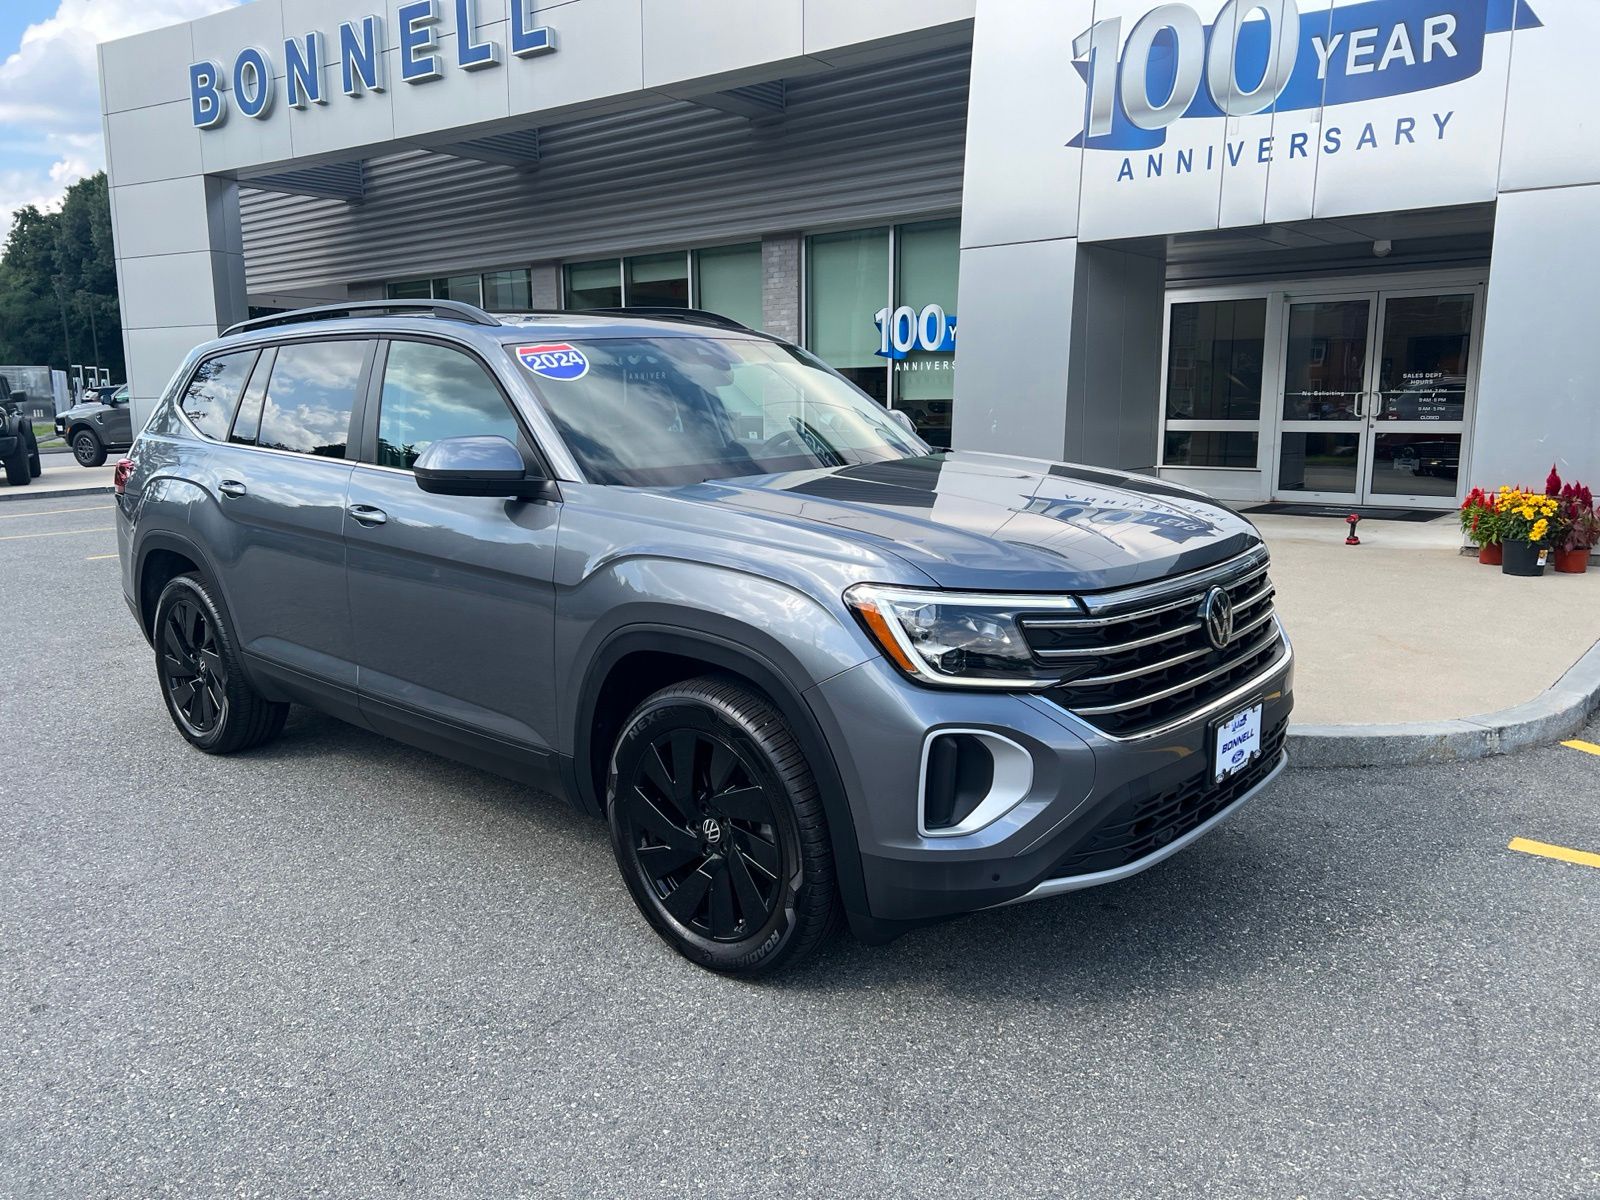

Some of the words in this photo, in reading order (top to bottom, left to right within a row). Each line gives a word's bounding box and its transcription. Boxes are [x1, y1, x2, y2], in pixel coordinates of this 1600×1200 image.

[189, 0, 557, 131] BONNELL
[1072, 0, 1299, 137] 100
[1311, 13, 1458, 81] YEAR
[1115, 110, 1456, 183] ANNIVERSARY
[875, 303, 946, 353] 100
[526, 351, 584, 371] 2024
[1222, 728, 1255, 755] BONNELL
